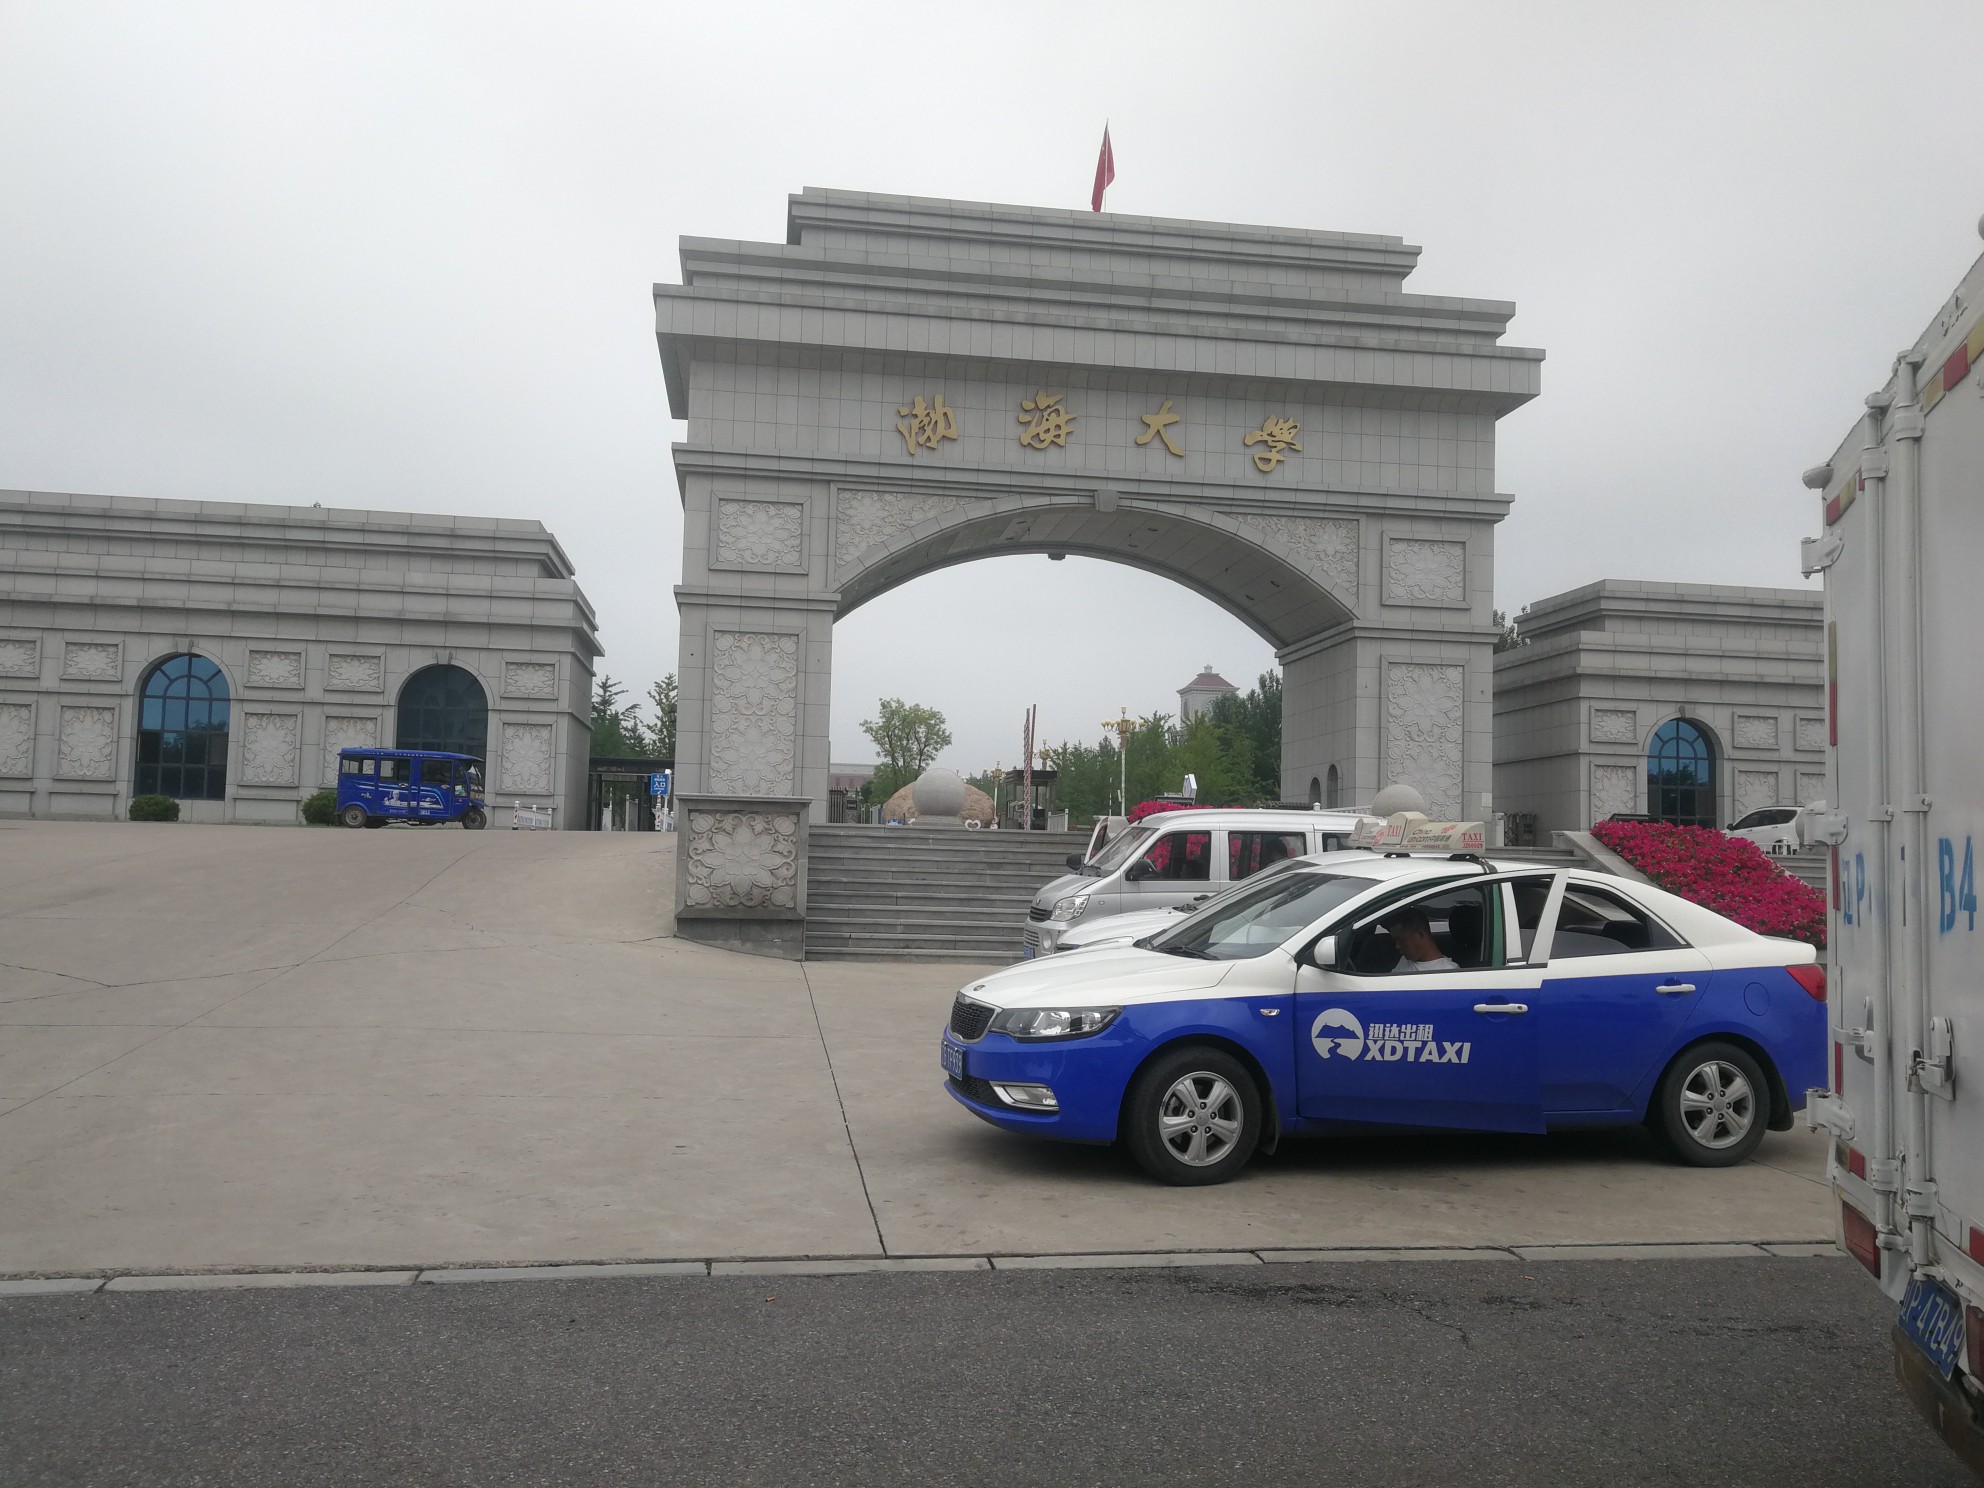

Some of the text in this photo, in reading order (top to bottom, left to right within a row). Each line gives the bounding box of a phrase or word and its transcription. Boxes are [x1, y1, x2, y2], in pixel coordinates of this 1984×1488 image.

[897, 389, 1302, 472] 渤海大学
[1387, 825, 1402, 838] TAXI
[1461, 832, 1483, 841] TAXI
[1368, 1023, 1434, 1041] 迅达出租
[1364, 1040, 1472, 1064] XDTAXI
